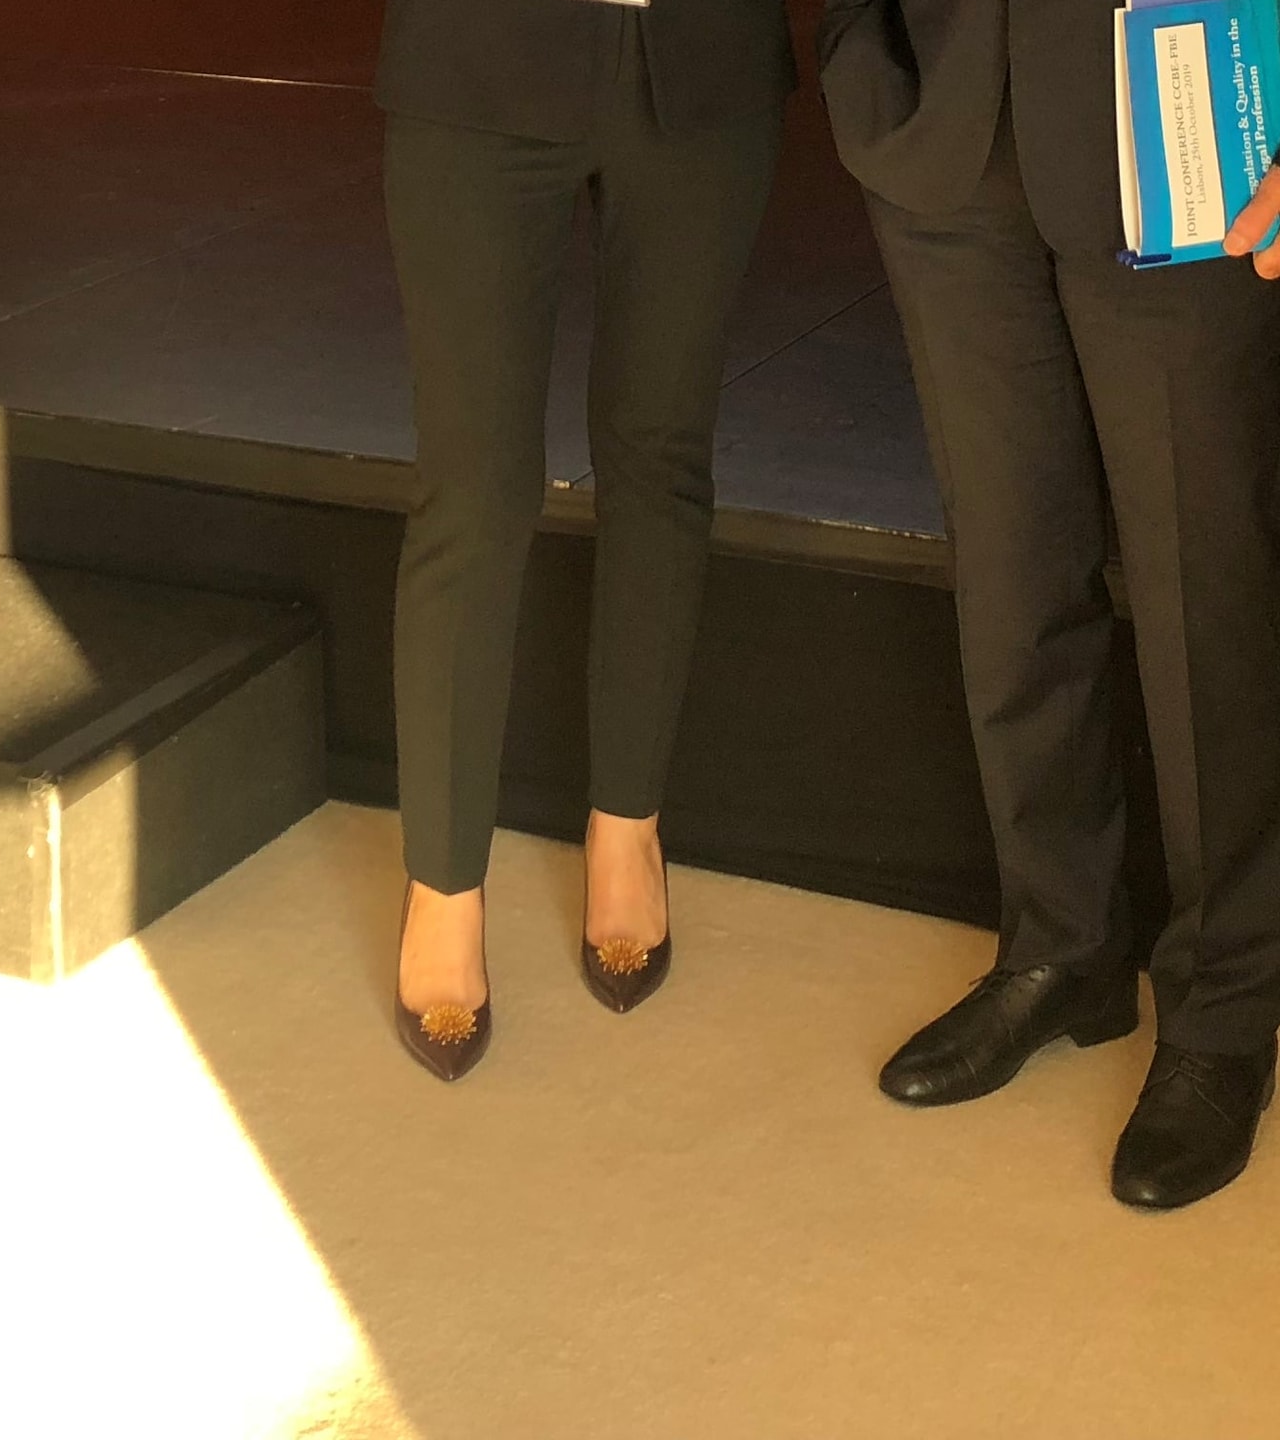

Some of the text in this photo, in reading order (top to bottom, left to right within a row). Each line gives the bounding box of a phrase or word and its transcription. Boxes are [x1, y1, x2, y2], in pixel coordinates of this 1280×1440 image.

[1183, 63, 1193, 89] 2019
[1186, 91, 1198, 136] October
[1228, 18, 1260, 196] egulation & Quality in the
[1249, 65, 1273, 173] egal Profession
[1168, 33, 1198, 237] JOINT CONFERENCE CCBE-FBE
